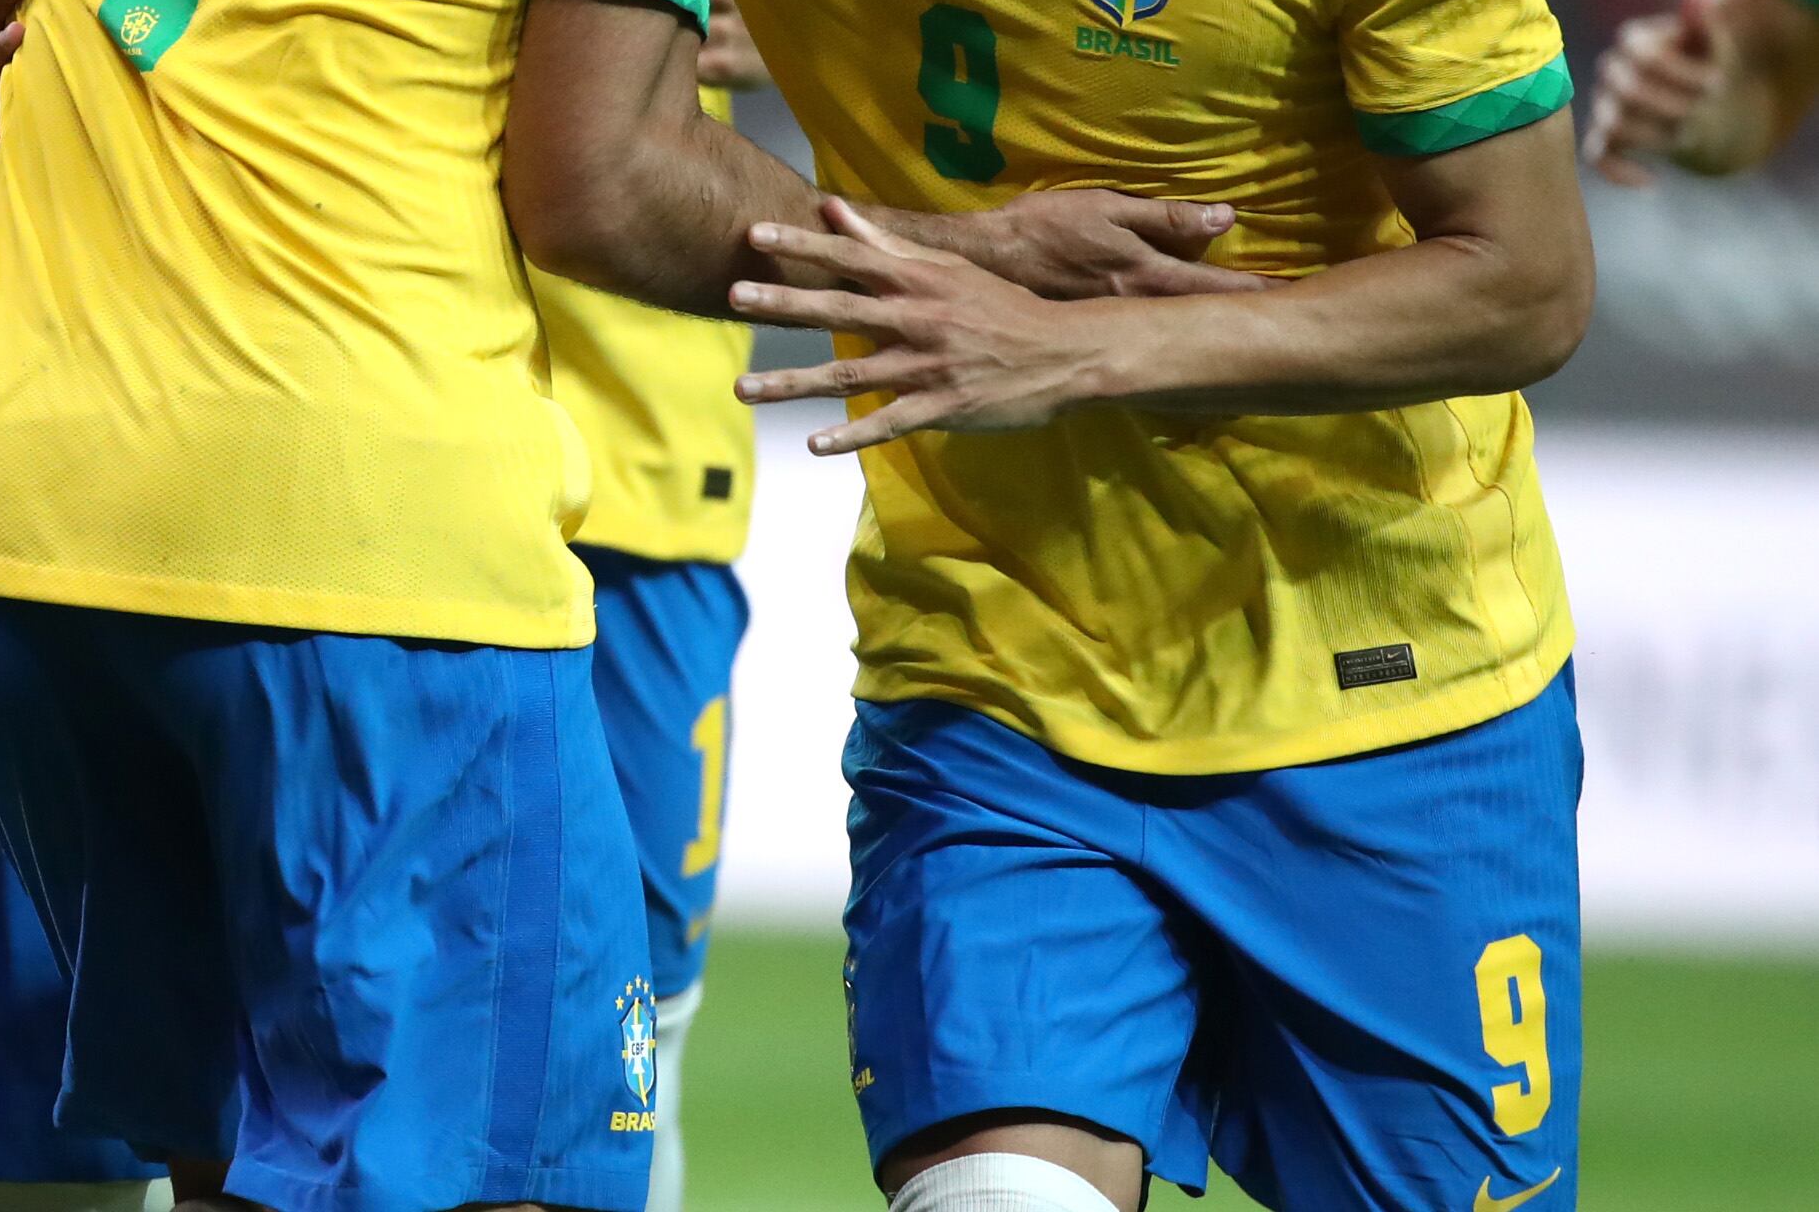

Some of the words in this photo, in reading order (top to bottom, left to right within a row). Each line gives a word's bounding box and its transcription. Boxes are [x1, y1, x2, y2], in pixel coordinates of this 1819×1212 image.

[917, 3, 1006, 183] 9
[1076, 25, 1180, 66] BRASIL
[631, 1042, 645, 1056] CBF
[1475, 933, 1551, 1136] 9
